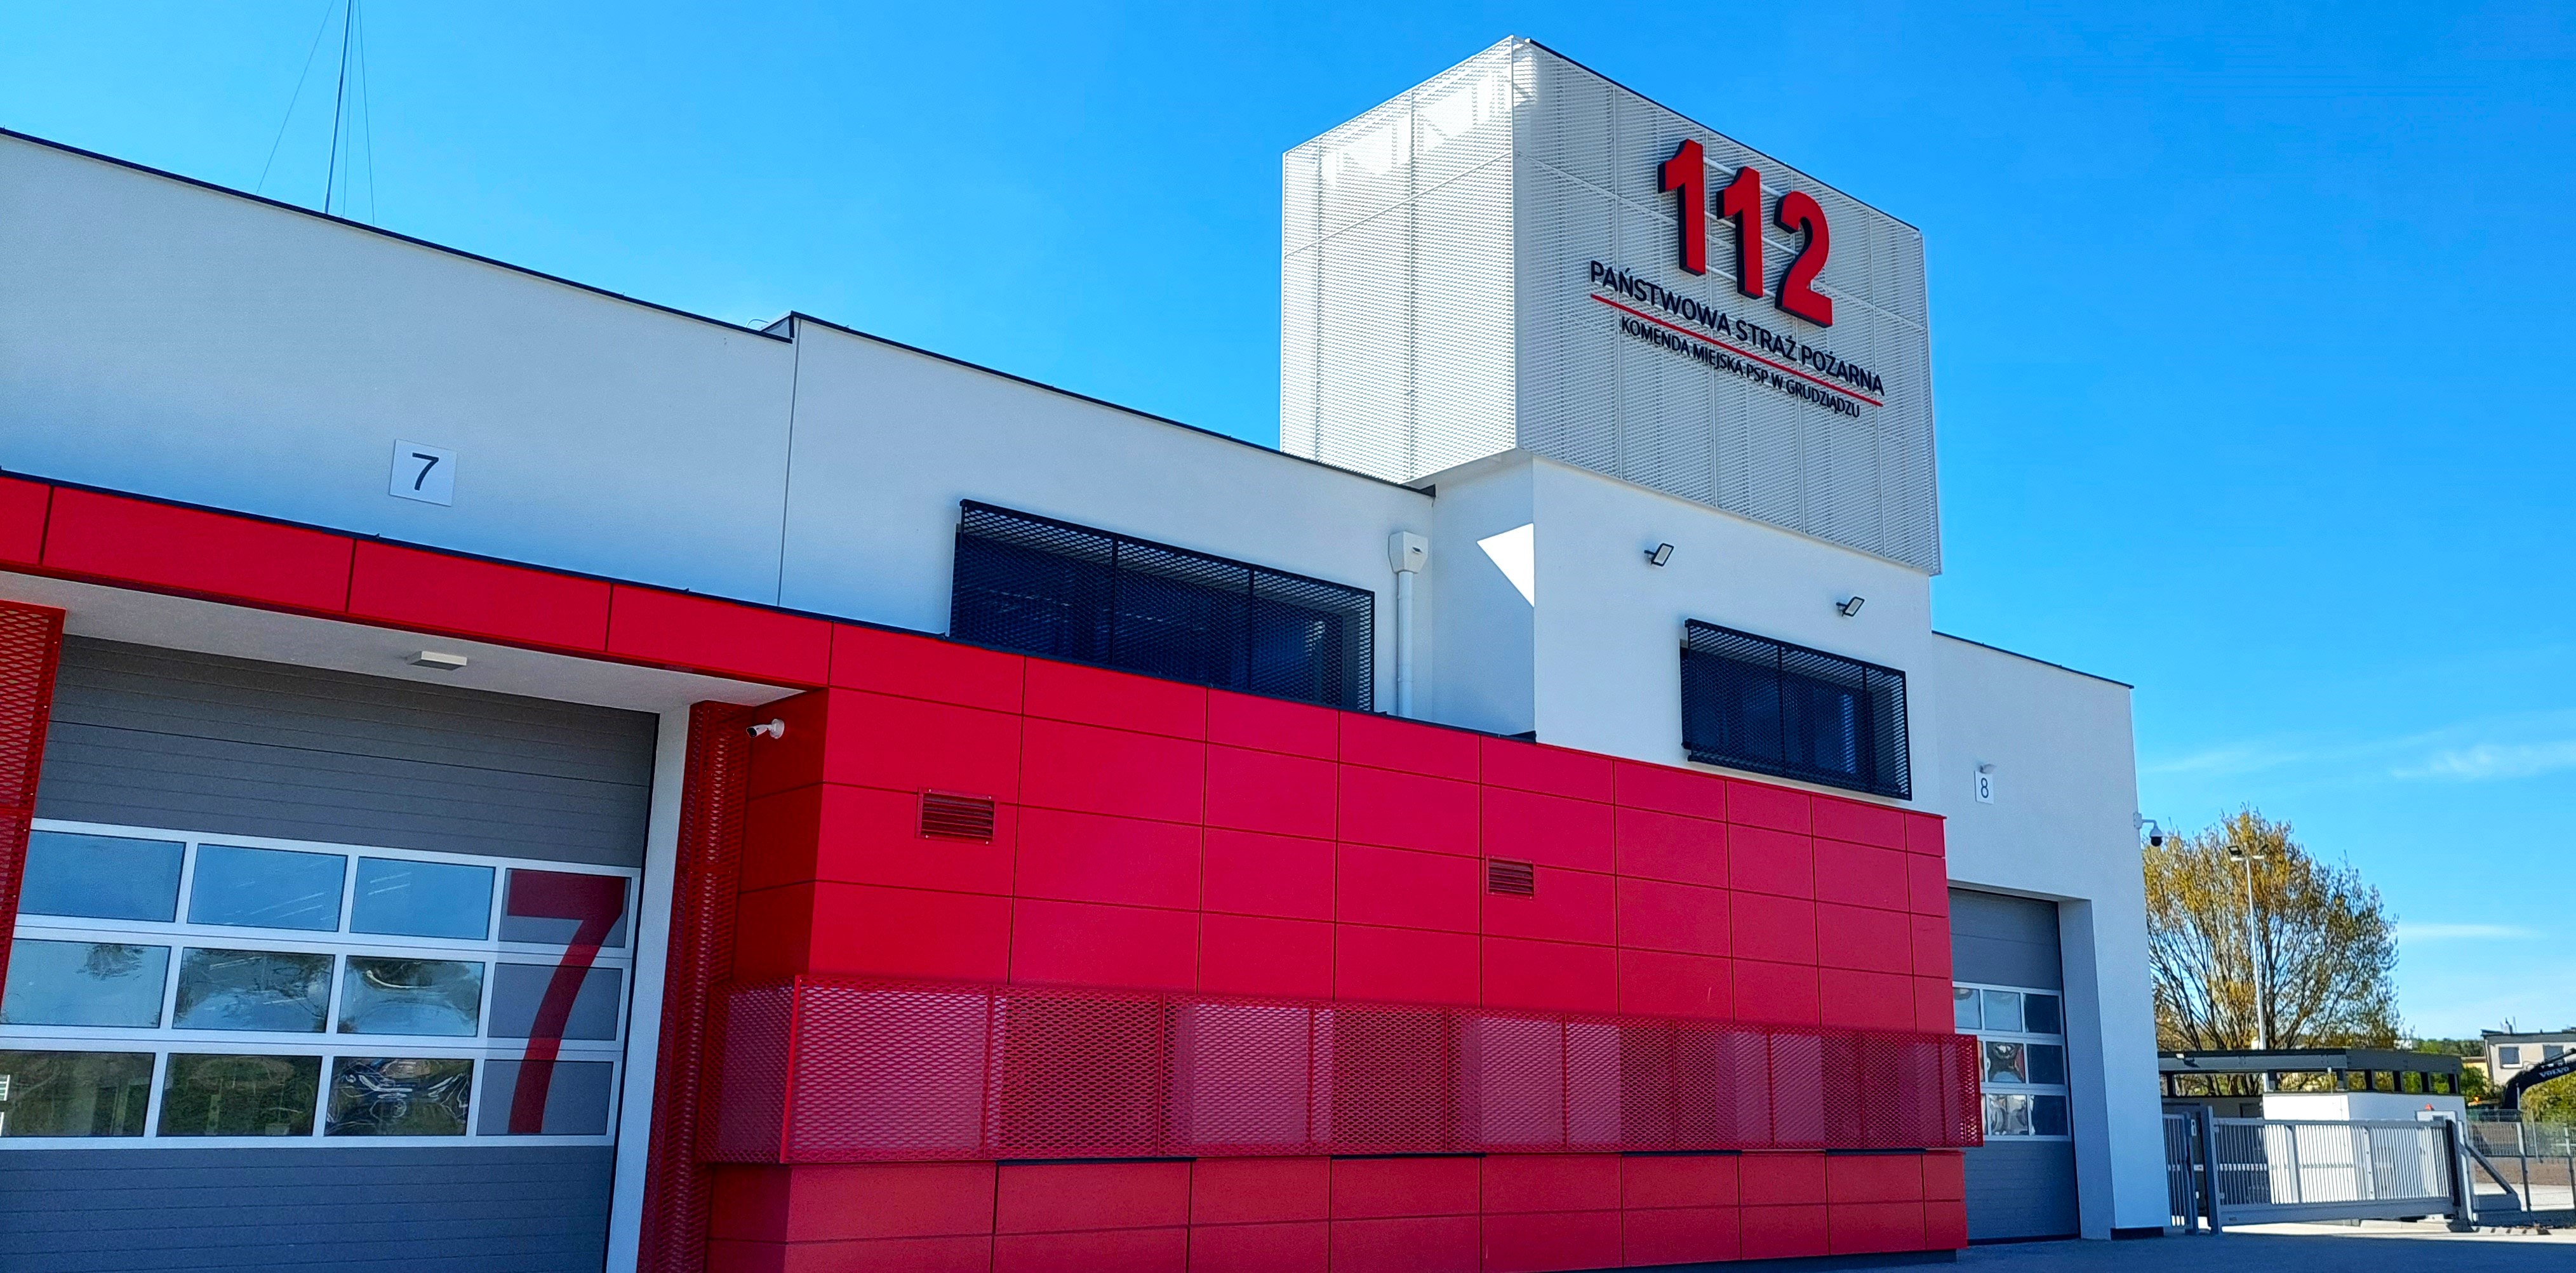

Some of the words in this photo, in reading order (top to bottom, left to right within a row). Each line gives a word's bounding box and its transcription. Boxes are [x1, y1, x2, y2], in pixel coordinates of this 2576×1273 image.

[1658, 138, 1833, 329] 112
[1590, 260, 1732, 337] PAŃSTWOWA
[1736, 319, 1798, 362] STRAŻ
[1801, 344, 1885, 397] POŻARNA
[1621, 316, 1690, 357] KOMENDA
[1693, 343, 1744, 376] MIEJSKA
[1746, 364, 1768, 384] PSP
[1771, 372, 1784, 390] W
[1785, 379, 1860, 418] GRUDZIĄDZU
[411, 451, 439, 491] 7
[1980, 777, 1989, 799] 8
[507, 868, 626, 1134] 7
[2539, 1066, 2570, 1078] VOLVO
